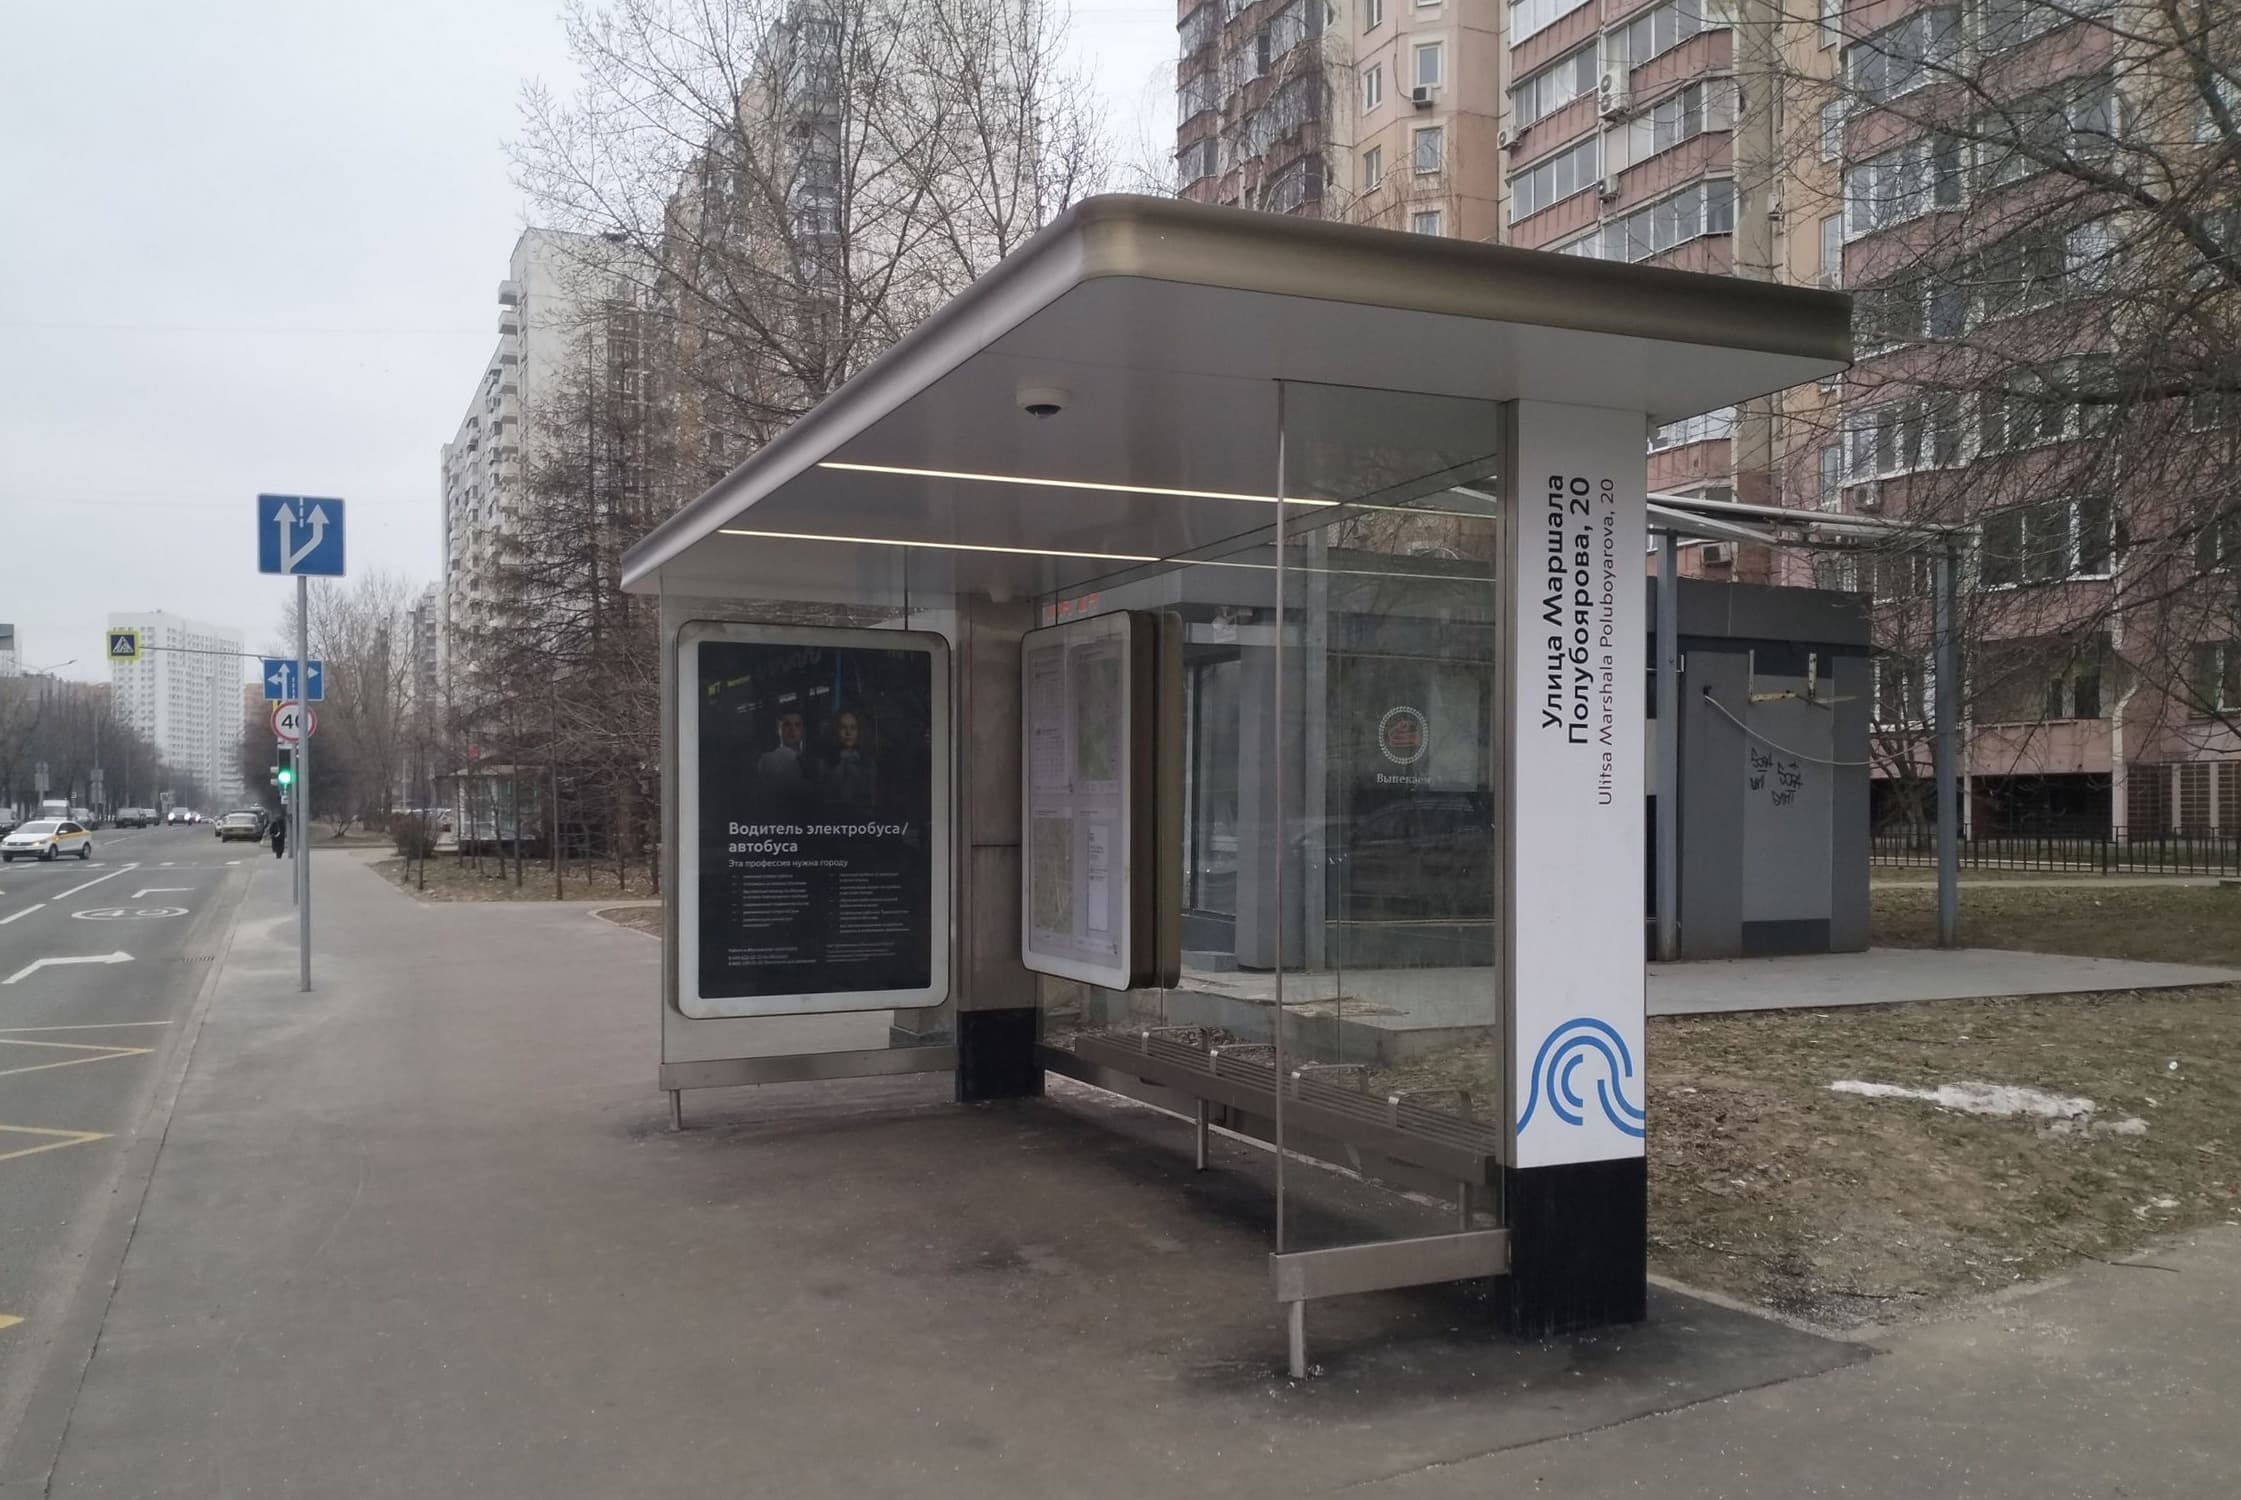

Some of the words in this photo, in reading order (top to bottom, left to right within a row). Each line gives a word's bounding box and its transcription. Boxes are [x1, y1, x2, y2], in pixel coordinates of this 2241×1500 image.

[1569, 477, 1590, 516] 20
[1599, 478, 1614, 504] 20
[1542, 475, 1567, 627] Маршала
[1598, 510, 1617, 648] Poluboyarova,
[1568, 525, 1594, 745] Полубоярова,
[1542, 635, 1566, 729] Улица
[1598, 654, 1614, 746] Marshala
[281, 714, 300, 730] 4
[1598, 752, 1614, 806] Ulitsa
[728, 821, 804, 837] Водитель
[807, 821, 909, 838] электробуса/
[728, 840, 799, 856] автобуса
[728, 859, 743, 869] Эта
[745, 859, 791, 870] профессия
[792, 860, 818, 870] нужна
[820, 860, 849, 870] городу
